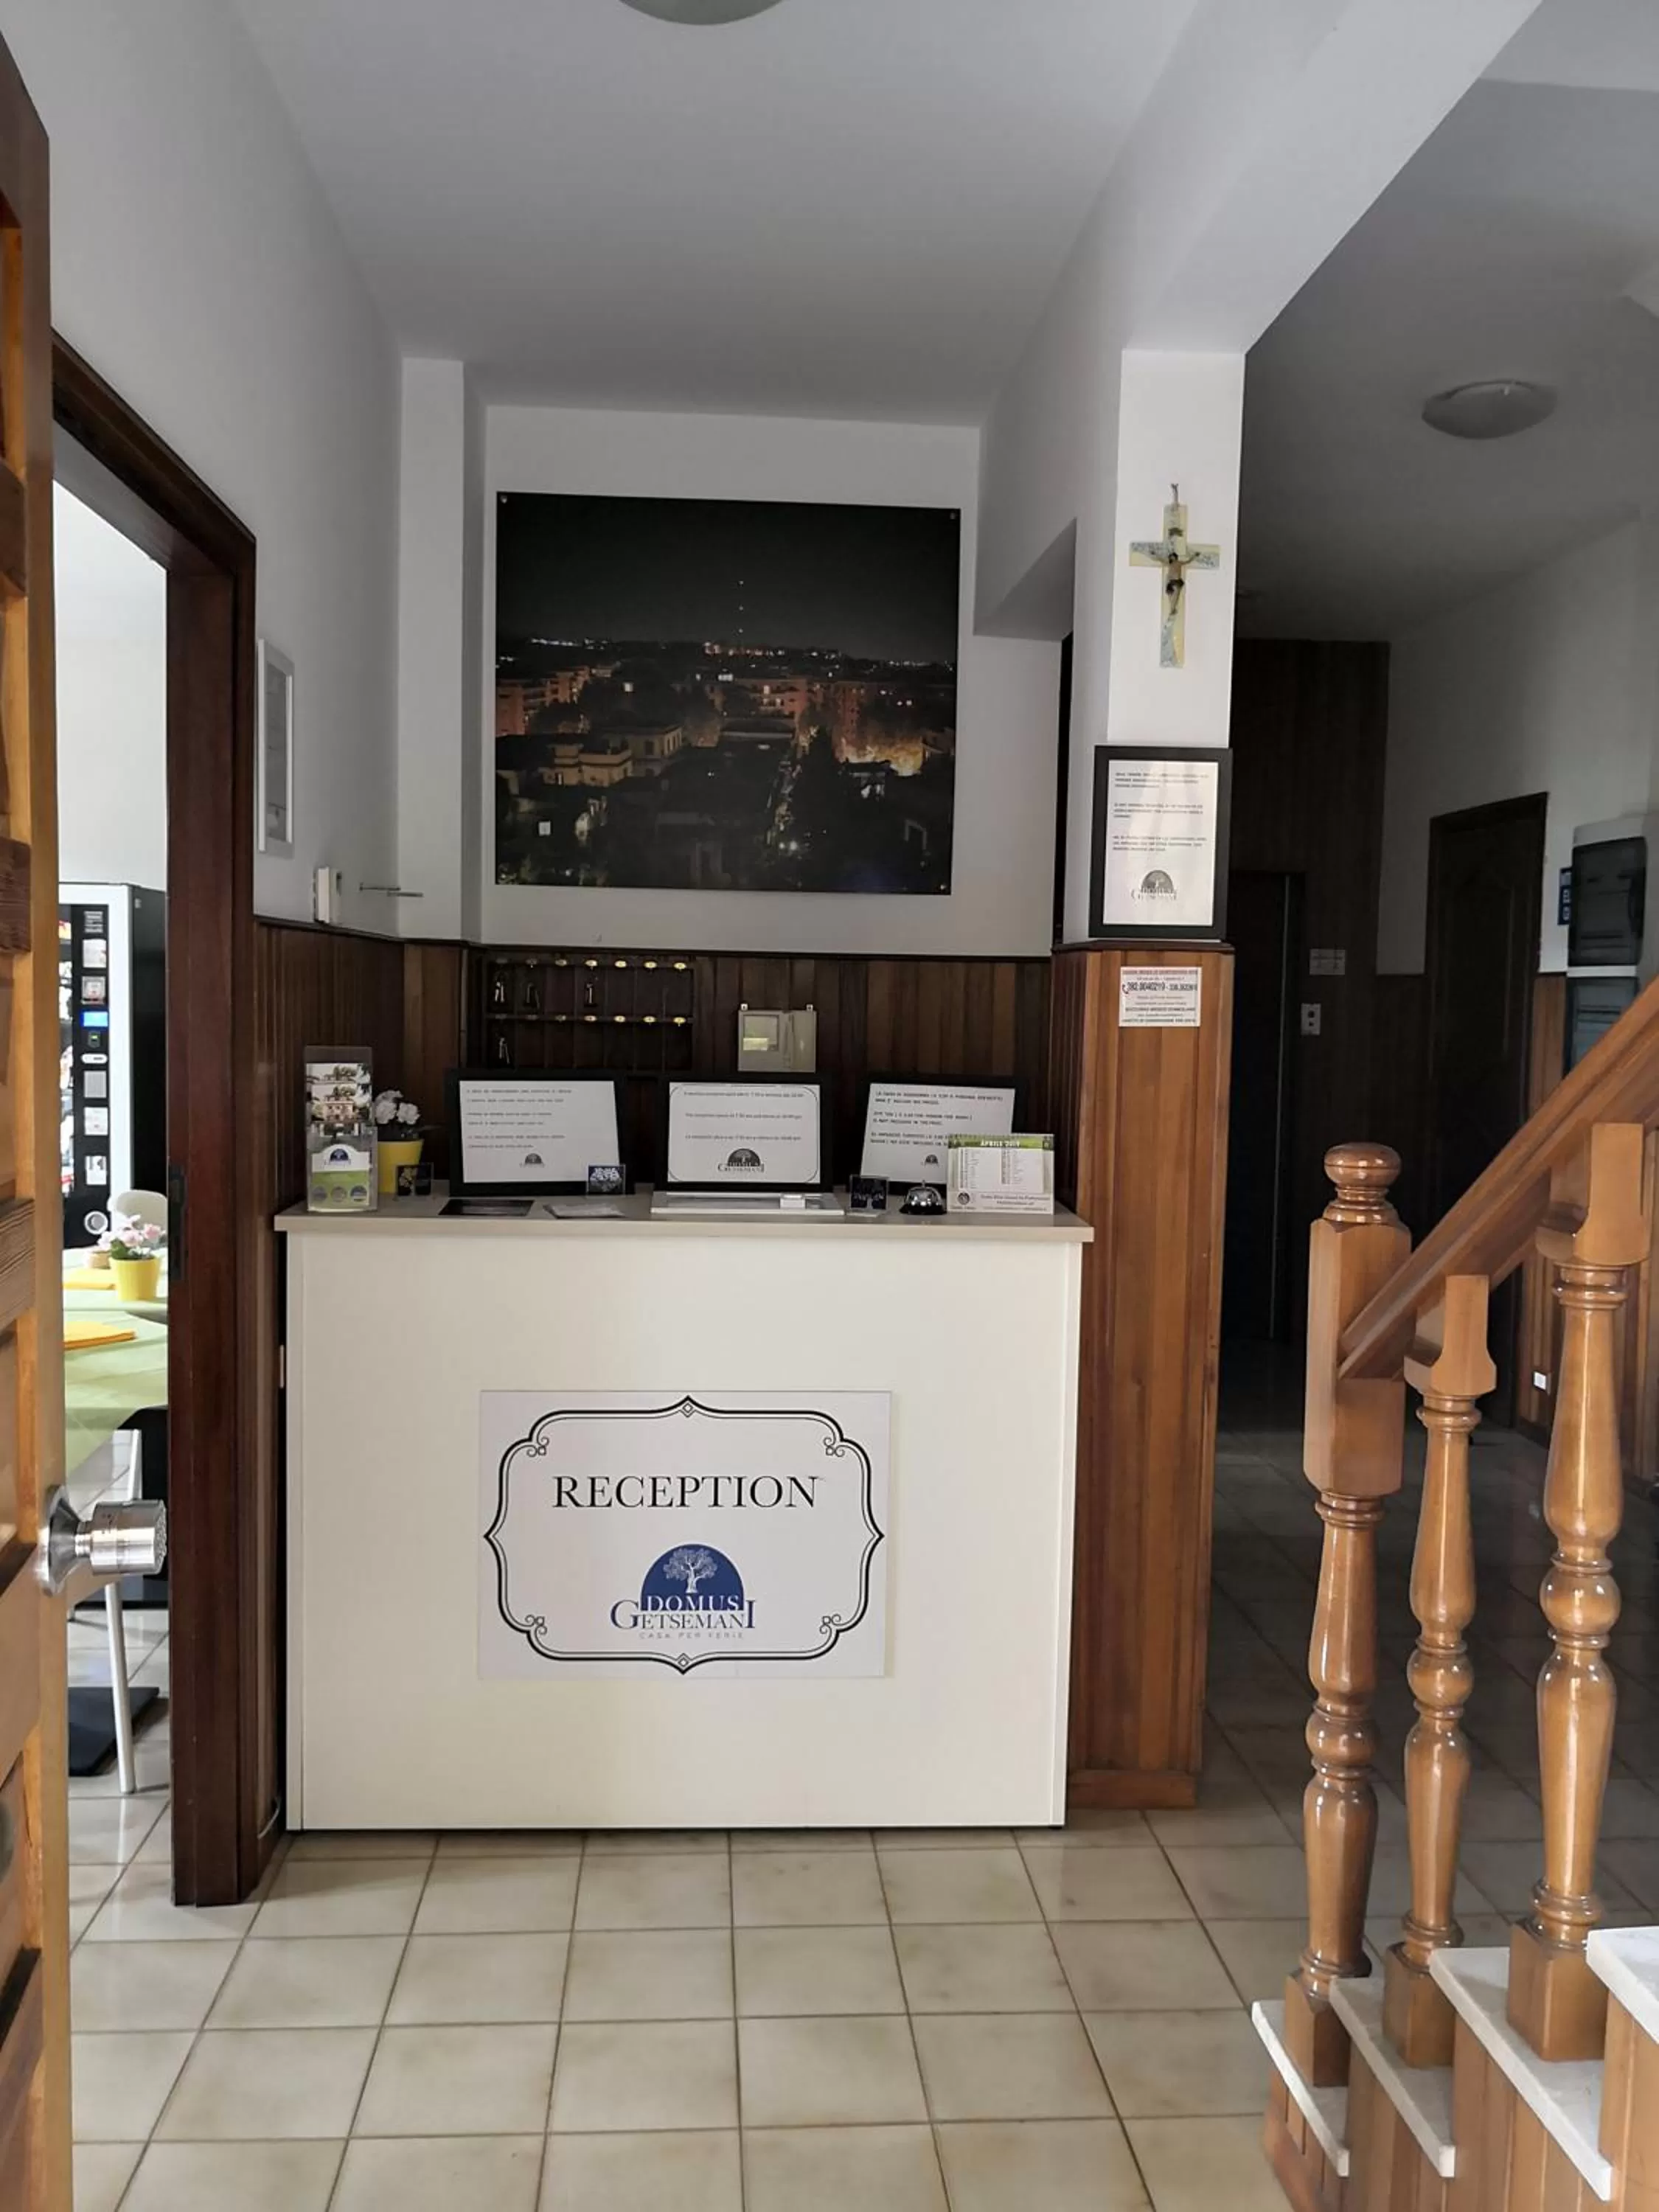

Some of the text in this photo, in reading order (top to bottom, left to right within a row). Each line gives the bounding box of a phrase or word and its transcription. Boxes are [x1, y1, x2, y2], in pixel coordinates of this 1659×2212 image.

[552, 1475, 820, 1509] RECEPTION
[611, 1599, 756, 1630] GETSEMANI
[647, 1595, 740, 1612] DOMUS
[678, 1632, 701, 1640] PER
